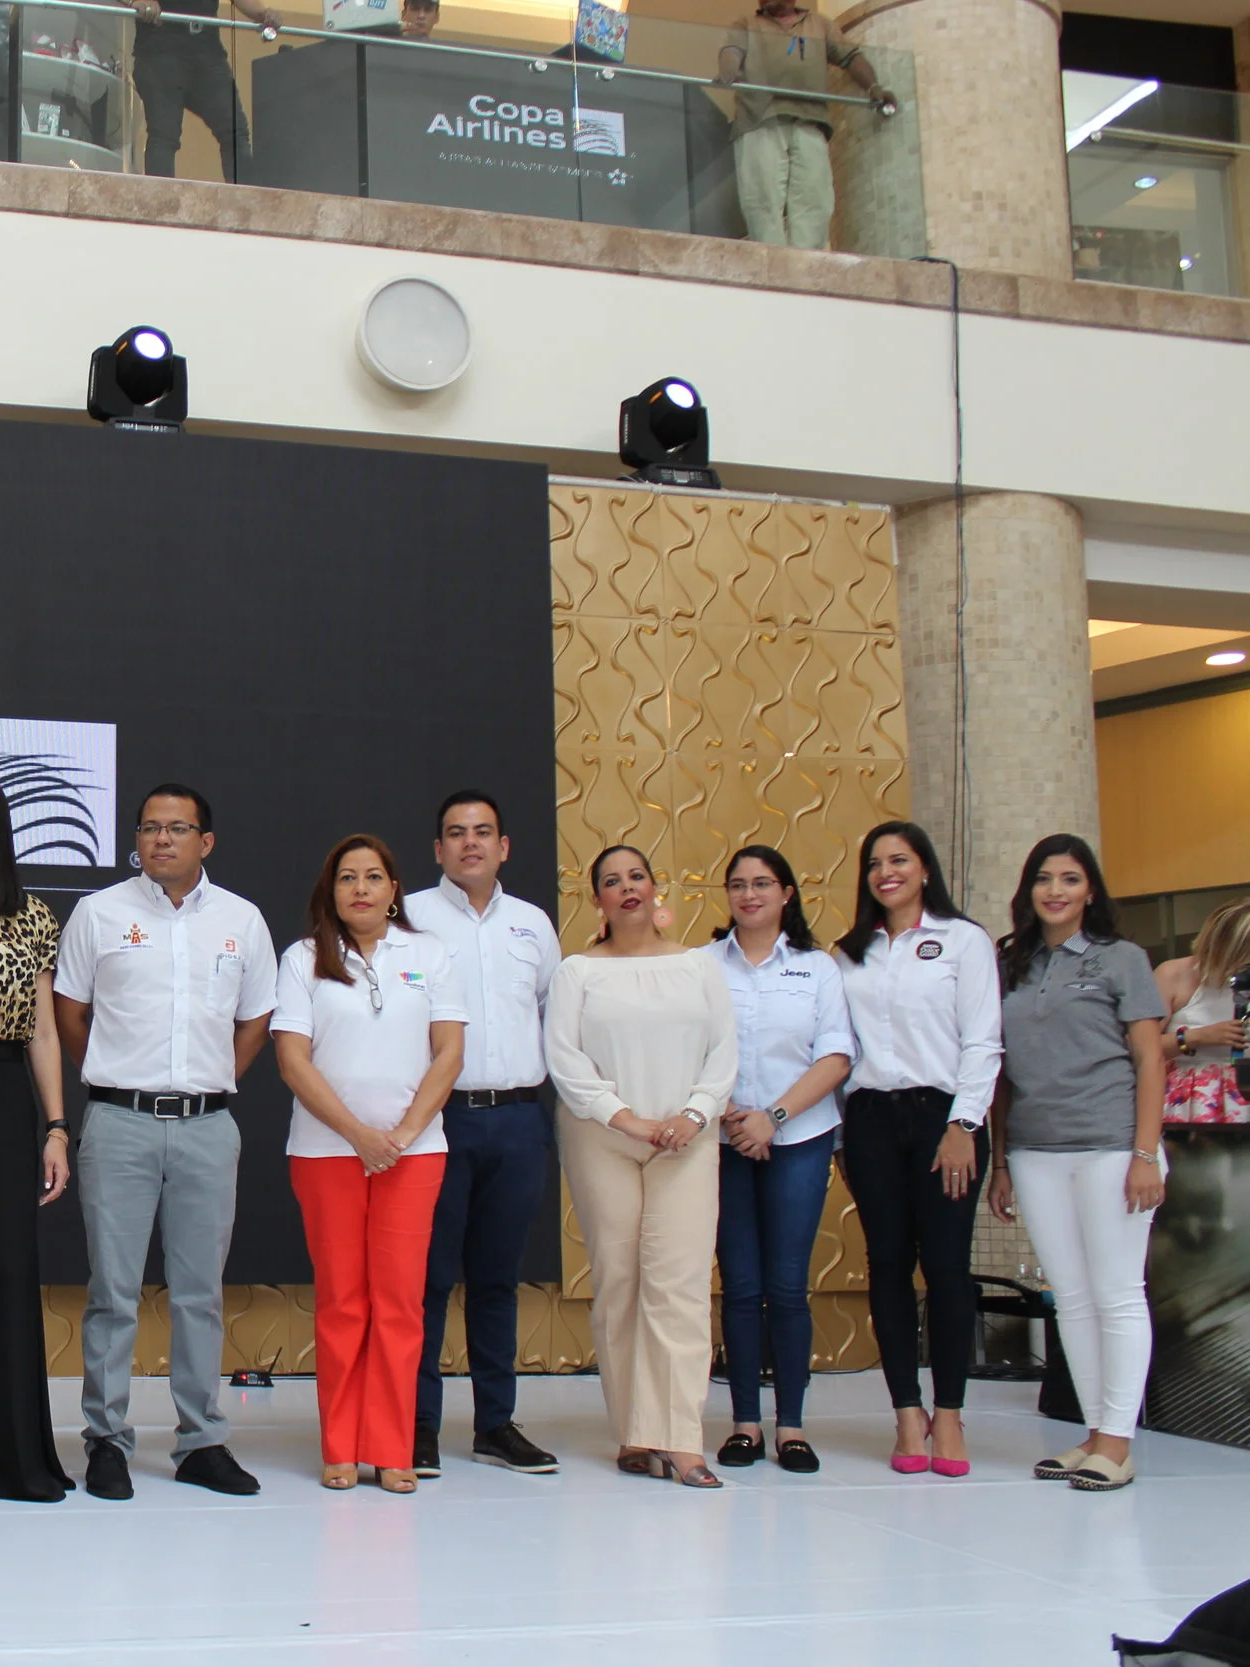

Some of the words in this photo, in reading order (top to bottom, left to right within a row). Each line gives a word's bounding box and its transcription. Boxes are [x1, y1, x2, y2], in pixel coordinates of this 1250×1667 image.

[468, 94, 565, 127] Copa
[426, 112, 567, 150] Airlines
[779, 969, 811, 978] Jeep
